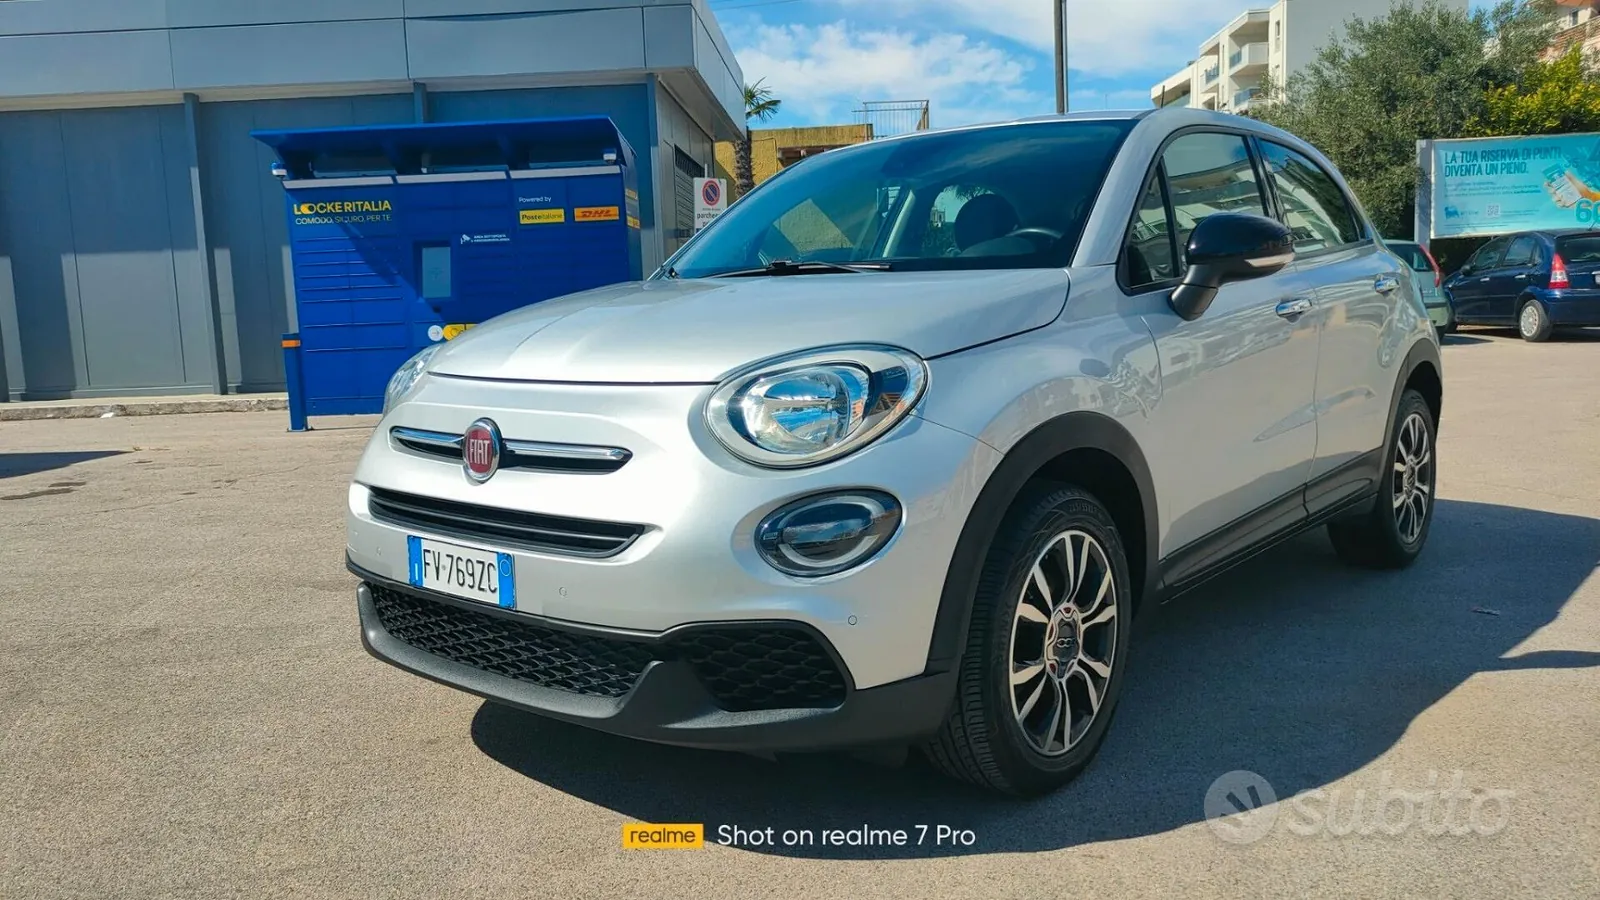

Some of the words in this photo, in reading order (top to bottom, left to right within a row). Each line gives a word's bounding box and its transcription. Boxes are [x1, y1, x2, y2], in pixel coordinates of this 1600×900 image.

[1445, 152, 1457, 164] LA
[1460, 150, 1479, 163] TUA
[1481, 148, 1520, 162] RISERVA
[1522, 147, 1532, 160] DI
[1533, 146, 1562, 160] PUNTI
[1445, 164, 1483, 177] DIVENTA
[1485, 163, 1499, 175] UN
[518, 196, 544, 204] Powered
[581, 209, 612, 218] DHL
[469, 439, 490, 465] FIAT
